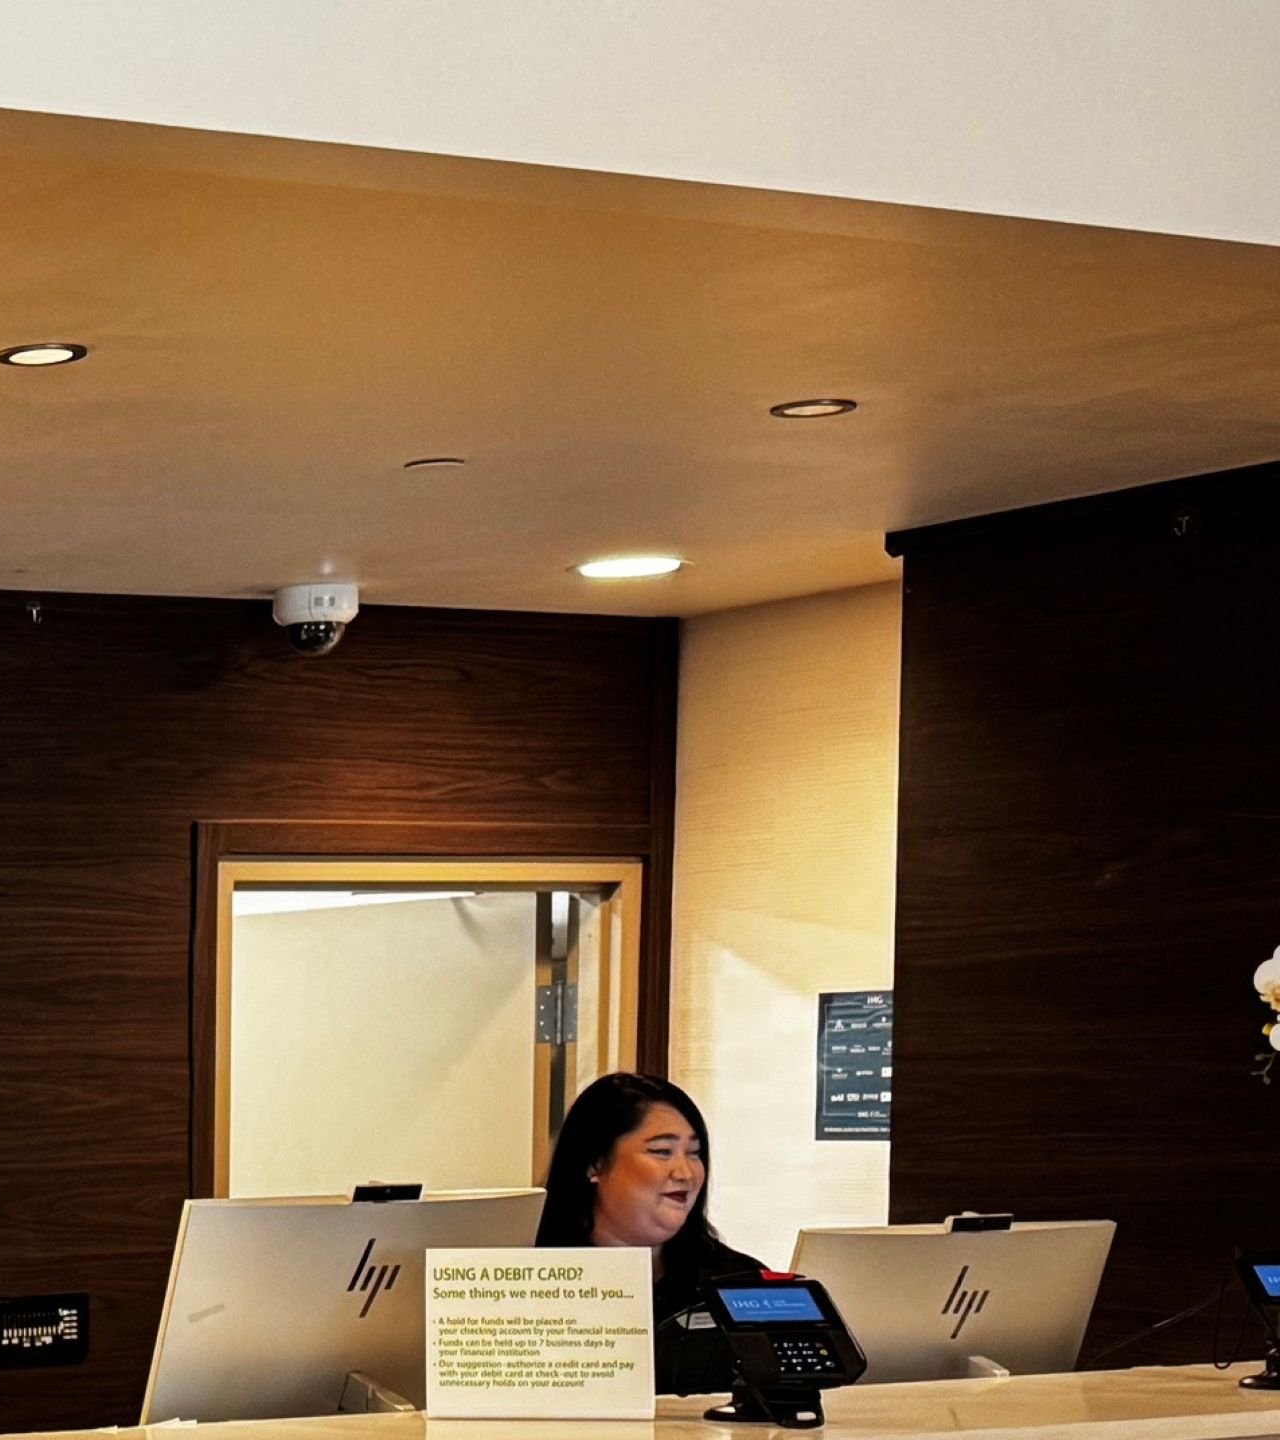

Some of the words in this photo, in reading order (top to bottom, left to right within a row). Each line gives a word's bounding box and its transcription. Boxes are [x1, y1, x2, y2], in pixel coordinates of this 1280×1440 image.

[347, 1238, 401, 1318] hp
[433, 1267, 476, 1281] USING
[480, 1268, 490, 1280] A
[494, 1267, 534, 1281] DEBIT
[538, 1267, 583, 1281] CARD?
[433, 1288, 466, 1299] Some
[469, 1287, 506, 1301] things
[509, 1290, 527, 1299] we
[530, 1287, 560, 1299] need
[563, 1289, 575, 1299] to
[579, 1287, 598, 1299] tell
[601, 1289, 634, 1301] you...
[941, 1265, 990, 1339] hp
[438, 1317, 445, 1325] A
[447, 1317, 465, 1325] hold
[467, 1317, 478, 1325] for
[481, 1317, 504, 1325] funds
[506, 1317, 521, 1325] will
[523, 1317, 534, 1325] be
[536, 1318, 564, 1326] placed
[439, 1328, 458, 1336] your
[460, 1327, 496, 1336] checking
[533, 1327, 544, 1336] by
[546, 1328, 565, 1336] your
[567, 1327, 603, 1335] financial
[605, 1327, 648, 1335] institution
[439, 1339, 464, 1347] Funds
[481, 1339, 492, 1347] be
[494, 1339, 513, 1347] held
[546, 1339, 582, 1347] business
[584, 1339, 603, 1348] days
[604, 1339, 615, 1348] by
[460, 1348, 496, 1356] financial
[497, 1348, 540, 1356] institution
[439, 1359, 454, 1368] Our
[555, 1360, 579, 1368] credit
[581, 1360, 600, 1368] card
[601, 1360, 618, 1368] and
[619, 1362, 635, 1370] pay
[460, 1371, 478, 1379] your
[591, 1370, 615, 1378] avoid
[439, 1380, 490, 1388] unnecessary
[492, 1379, 516, 1387] holds
